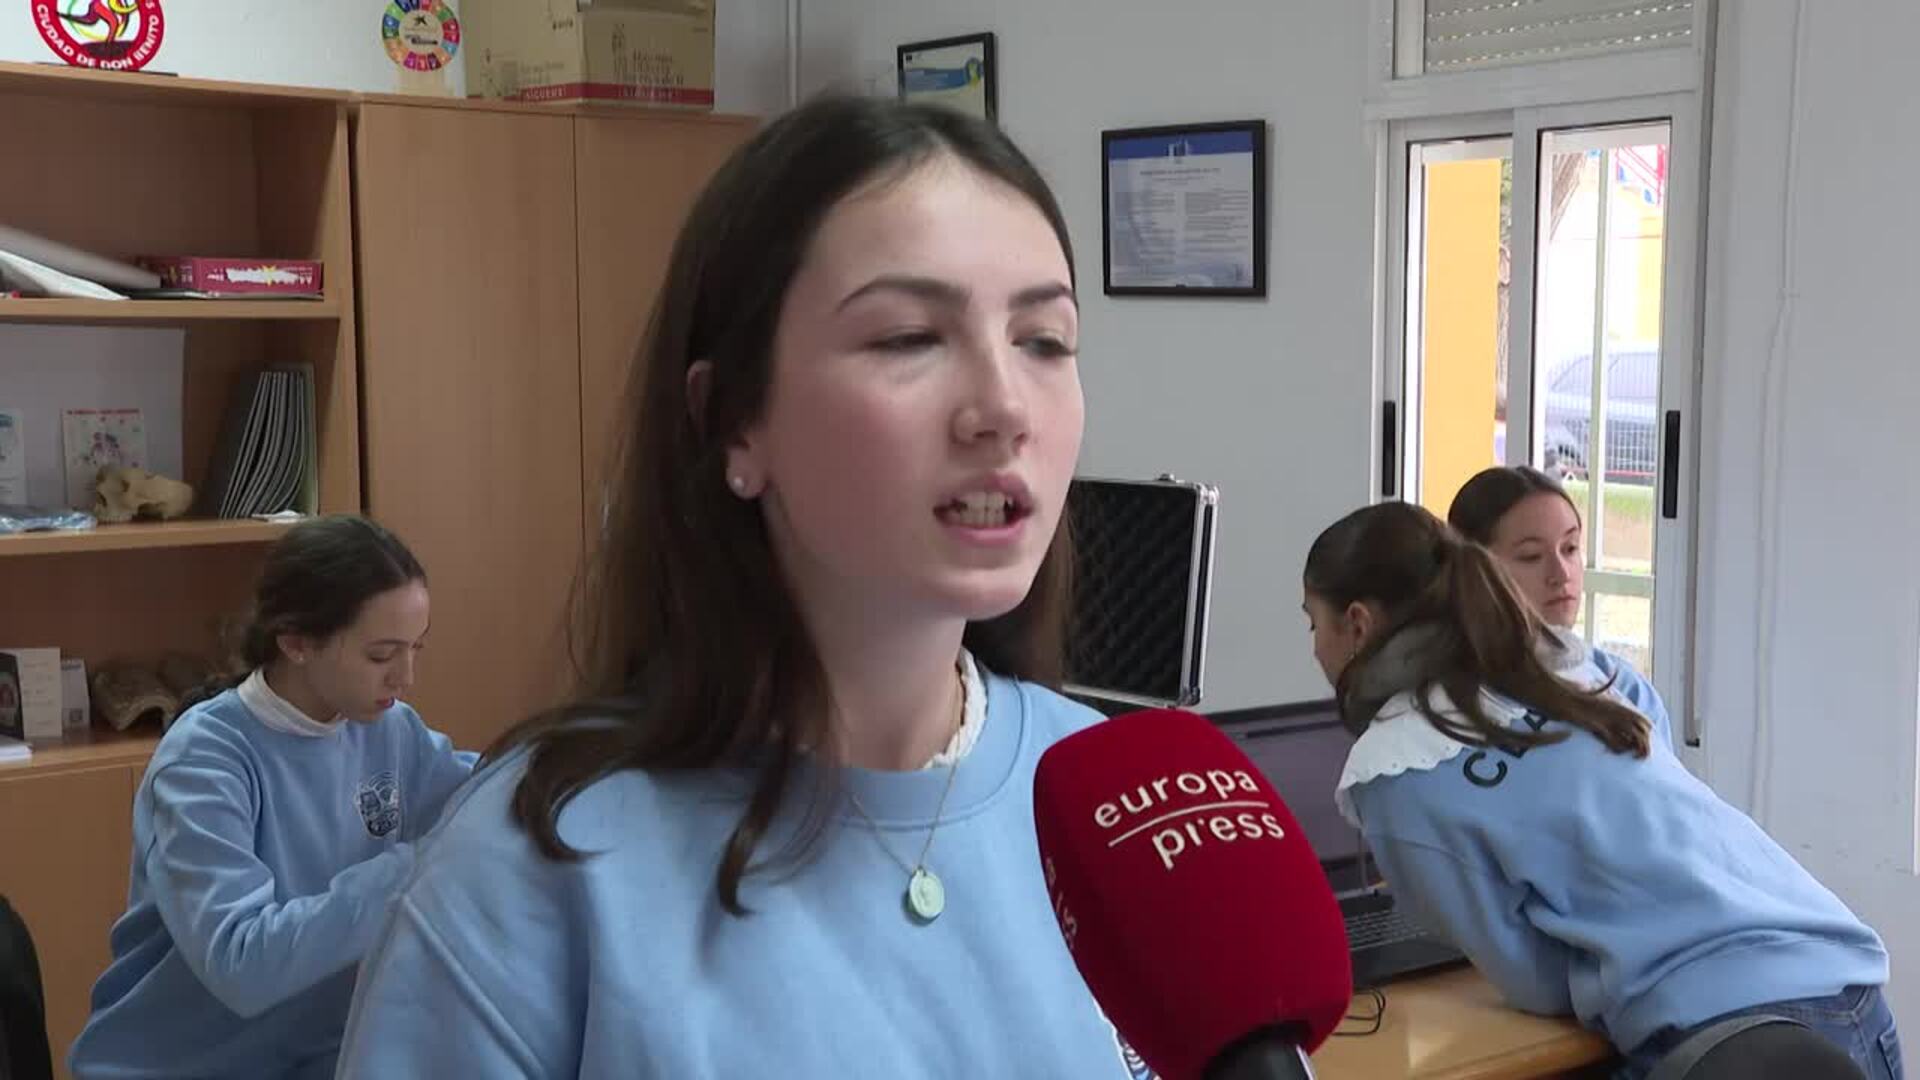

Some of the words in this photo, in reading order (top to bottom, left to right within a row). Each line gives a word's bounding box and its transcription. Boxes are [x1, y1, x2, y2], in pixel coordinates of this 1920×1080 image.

[37, 4, 75, 57] CIUDAD
[76, 53, 97, 67] DE
[100, 57, 134, 69] DON
[133, 14, 160, 62] BENITO
[1094, 769, 1260, 828] europa
[1152, 813, 1285, 870] press
